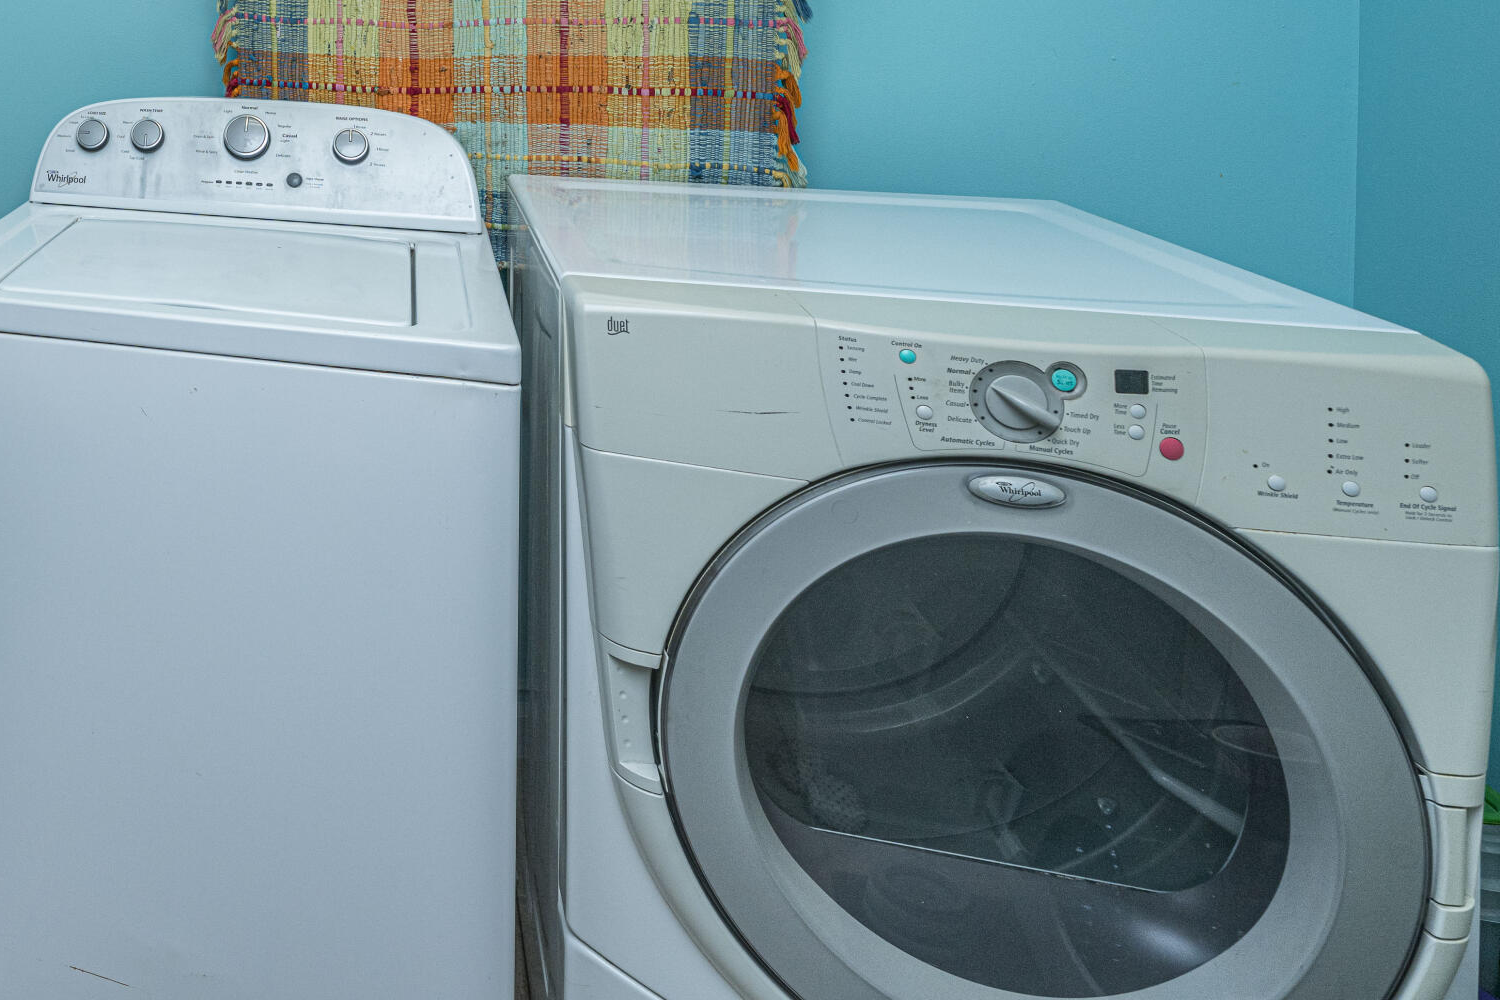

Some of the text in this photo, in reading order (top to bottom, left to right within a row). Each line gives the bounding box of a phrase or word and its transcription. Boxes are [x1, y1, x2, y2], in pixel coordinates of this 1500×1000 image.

[47, 173, 87, 185] Whirlpool
[607, 316, 630, 333] duet
[838, 335, 857, 343] Status
[891, 340, 913, 348] Control
[950, 355, 985, 365] Heavy Duty
[946, 367, 971, 375] Normal
[948, 380, 965, 388] Bulky
[947, 415, 972, 423] Delicate
[1070, 411, 1100, 421] Timed Dry
[915, 420, 938, 428] Dryness
[940, 436, 995, 447] Automatic Cycles
[1052, 438, 1080, 448] Quick Dry
[1029, 445, 1073, 455] Manual Cycles
[1000, 484, 1042, 498] Whirlpool
[1257, 490, 1299, 499] Wrinkle Shield
[1336, 499, 1374, 508] Temperature
